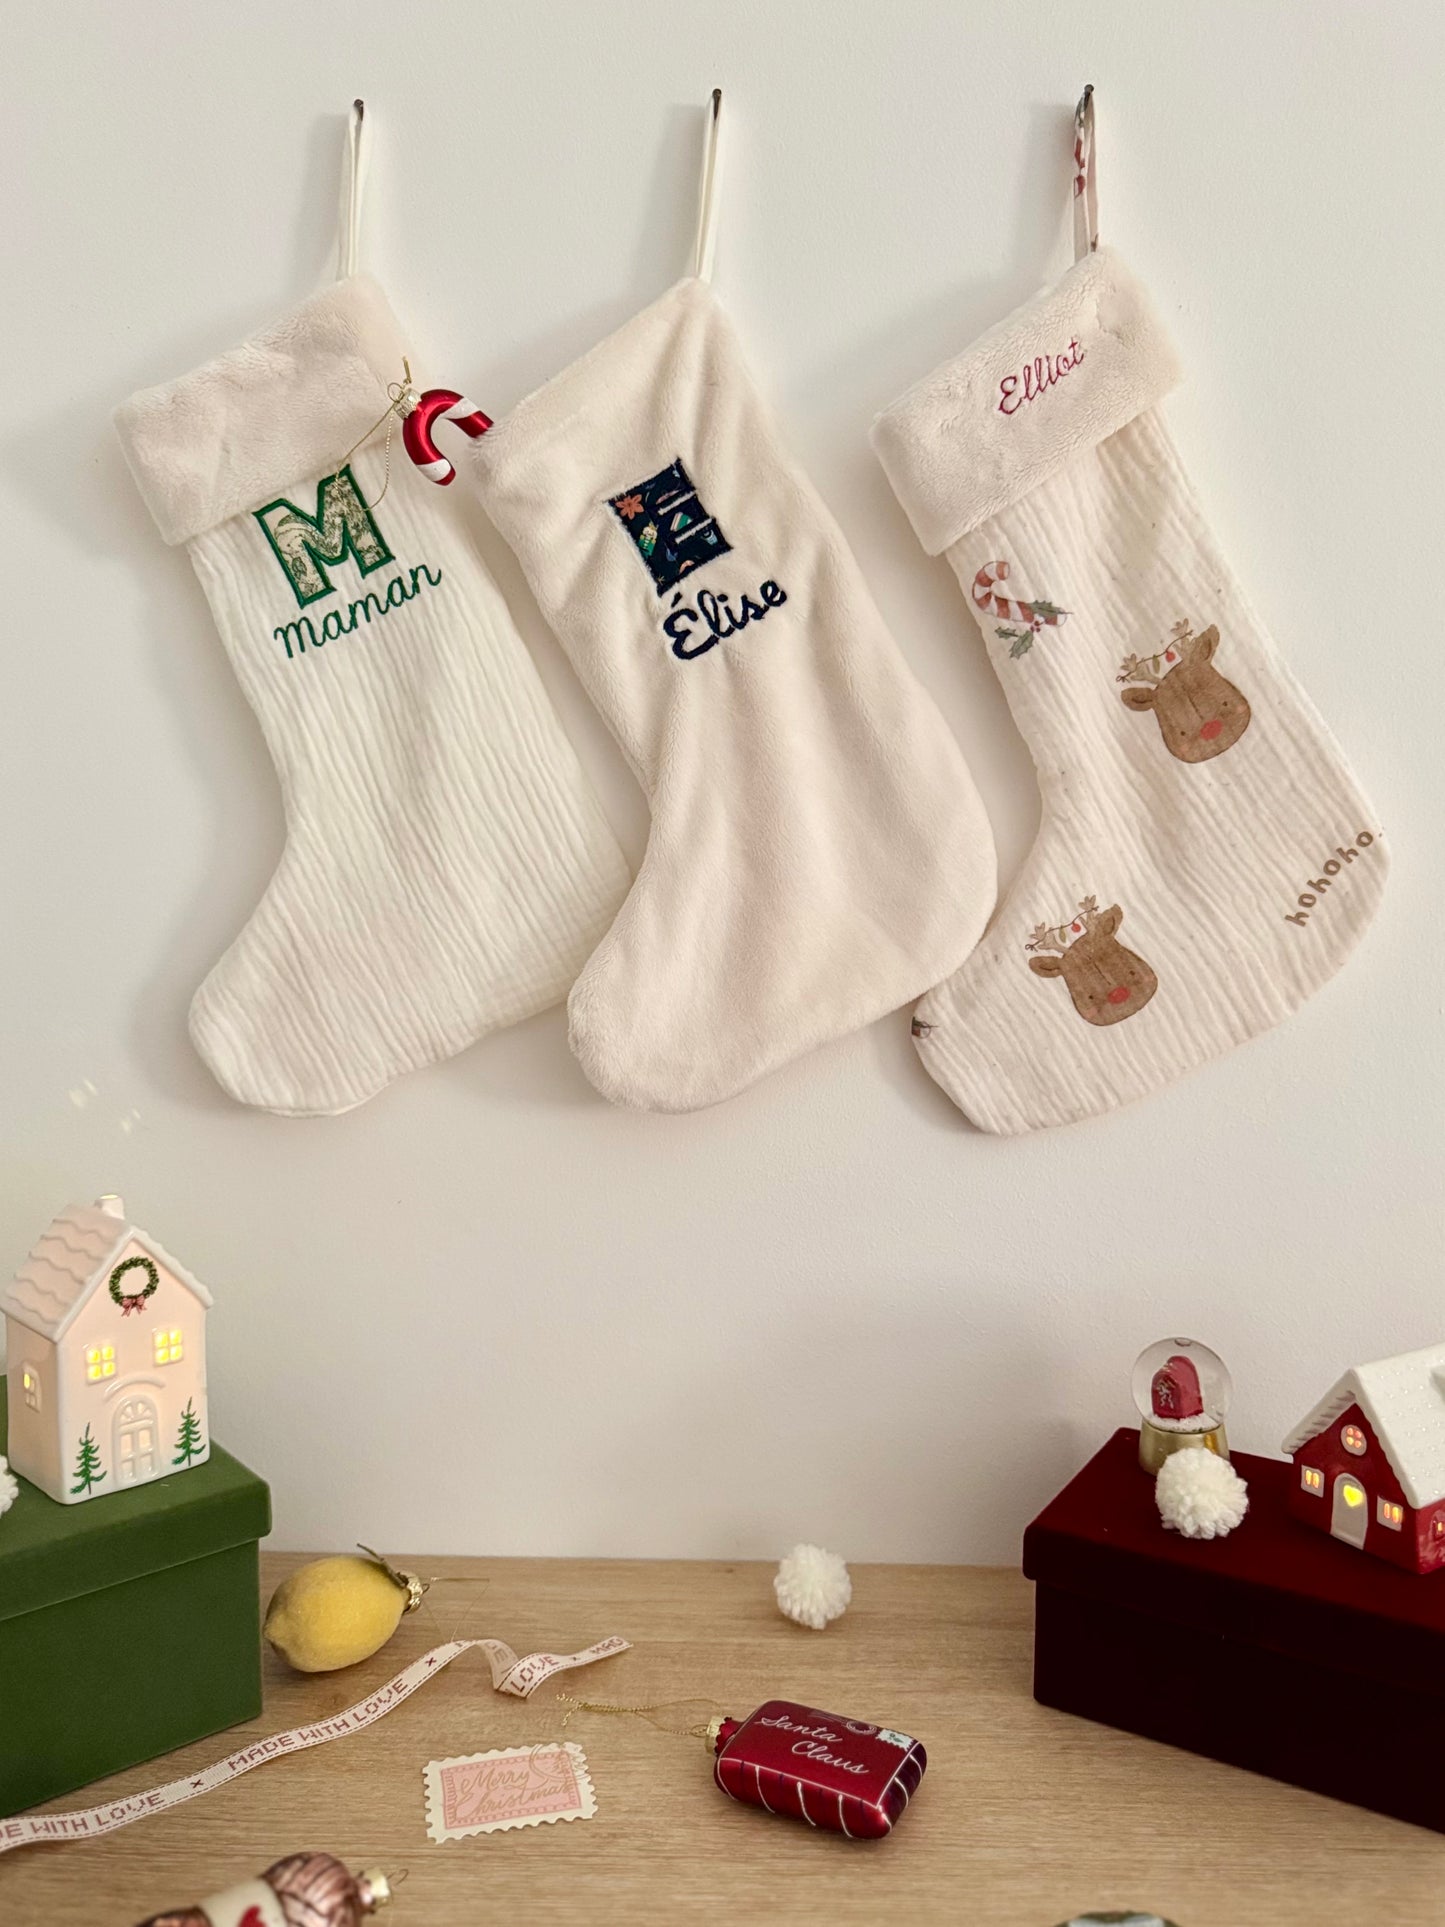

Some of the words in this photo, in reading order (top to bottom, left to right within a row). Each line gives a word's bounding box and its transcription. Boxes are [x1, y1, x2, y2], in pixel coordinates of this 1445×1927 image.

[998, 336, 1084, 415] Elliot
[252, 464, 396, 610] M
[273, 564, 442, 659] maman
[663, 580, 787, 660] Élise
[1284, 831, 1373, 927] hohoho
[511, 1656, 559, 1692] LOVE
[228, 1735, 295, 1771] MADE
[298, 1719, 350, 1742] WITH
[352, 1678, 408, 1723] LOVE
[754, 1715, 843, 1742] Santa
[791, 1740, 869, 1774] Claus
[0, 1823, 24, 1839] E
[30, 1817, 89, 1835] WITH
[96, 1792, 164, 1827] LOVE
[461, 1768, 530, 1794] Merry
